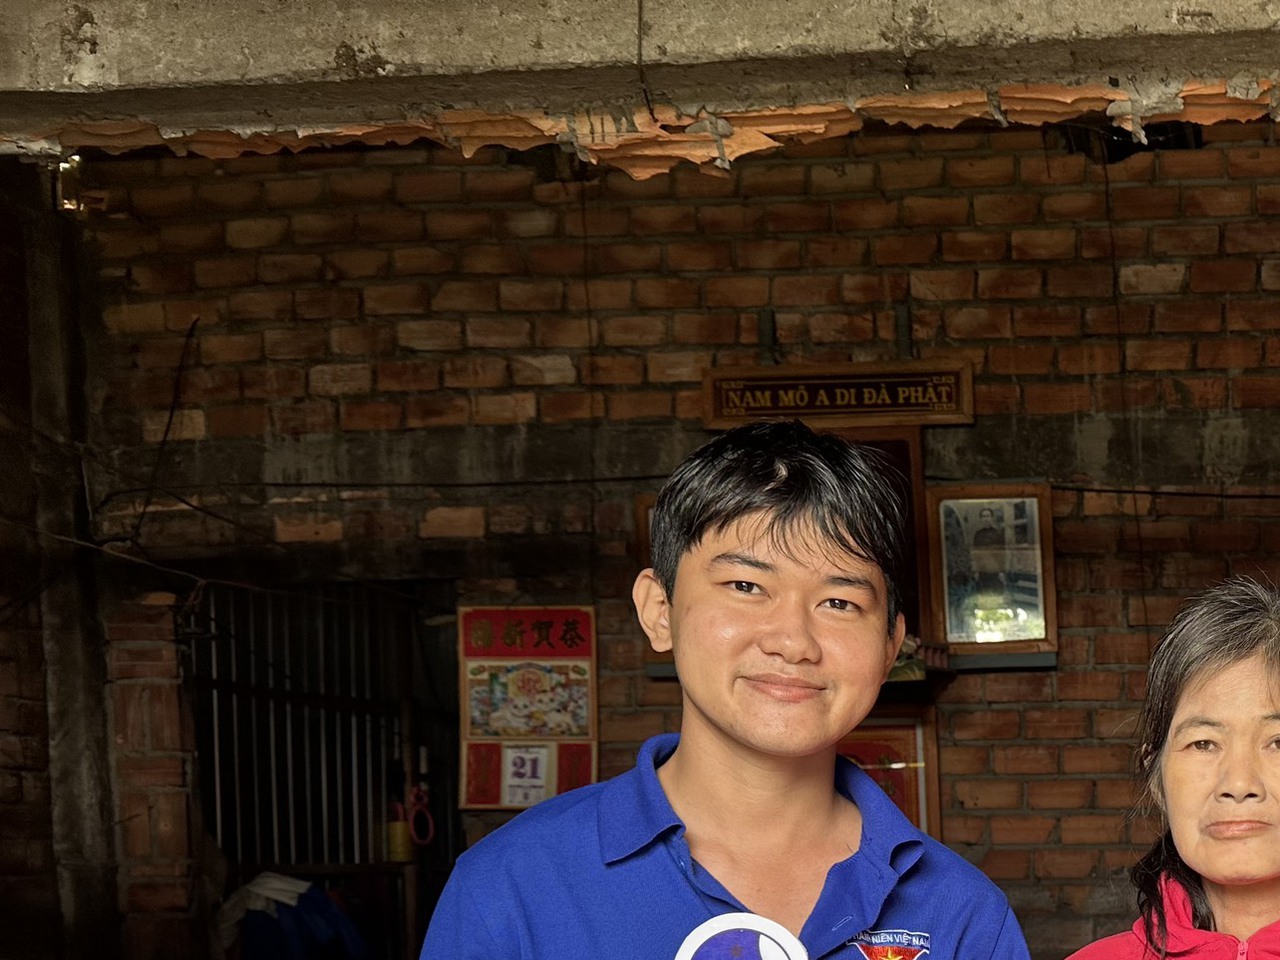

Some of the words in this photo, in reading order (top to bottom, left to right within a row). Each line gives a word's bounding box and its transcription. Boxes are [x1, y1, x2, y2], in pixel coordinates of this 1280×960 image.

[728, 388, 772, 408] NAM
[778, 386, 809, 407] MÔ
[814, 390, 831, 406] A
[835, 389, 857, 406] DI
[863, 383, 892, 405] ĐÀ
[511, 755, 542, 780] 21
